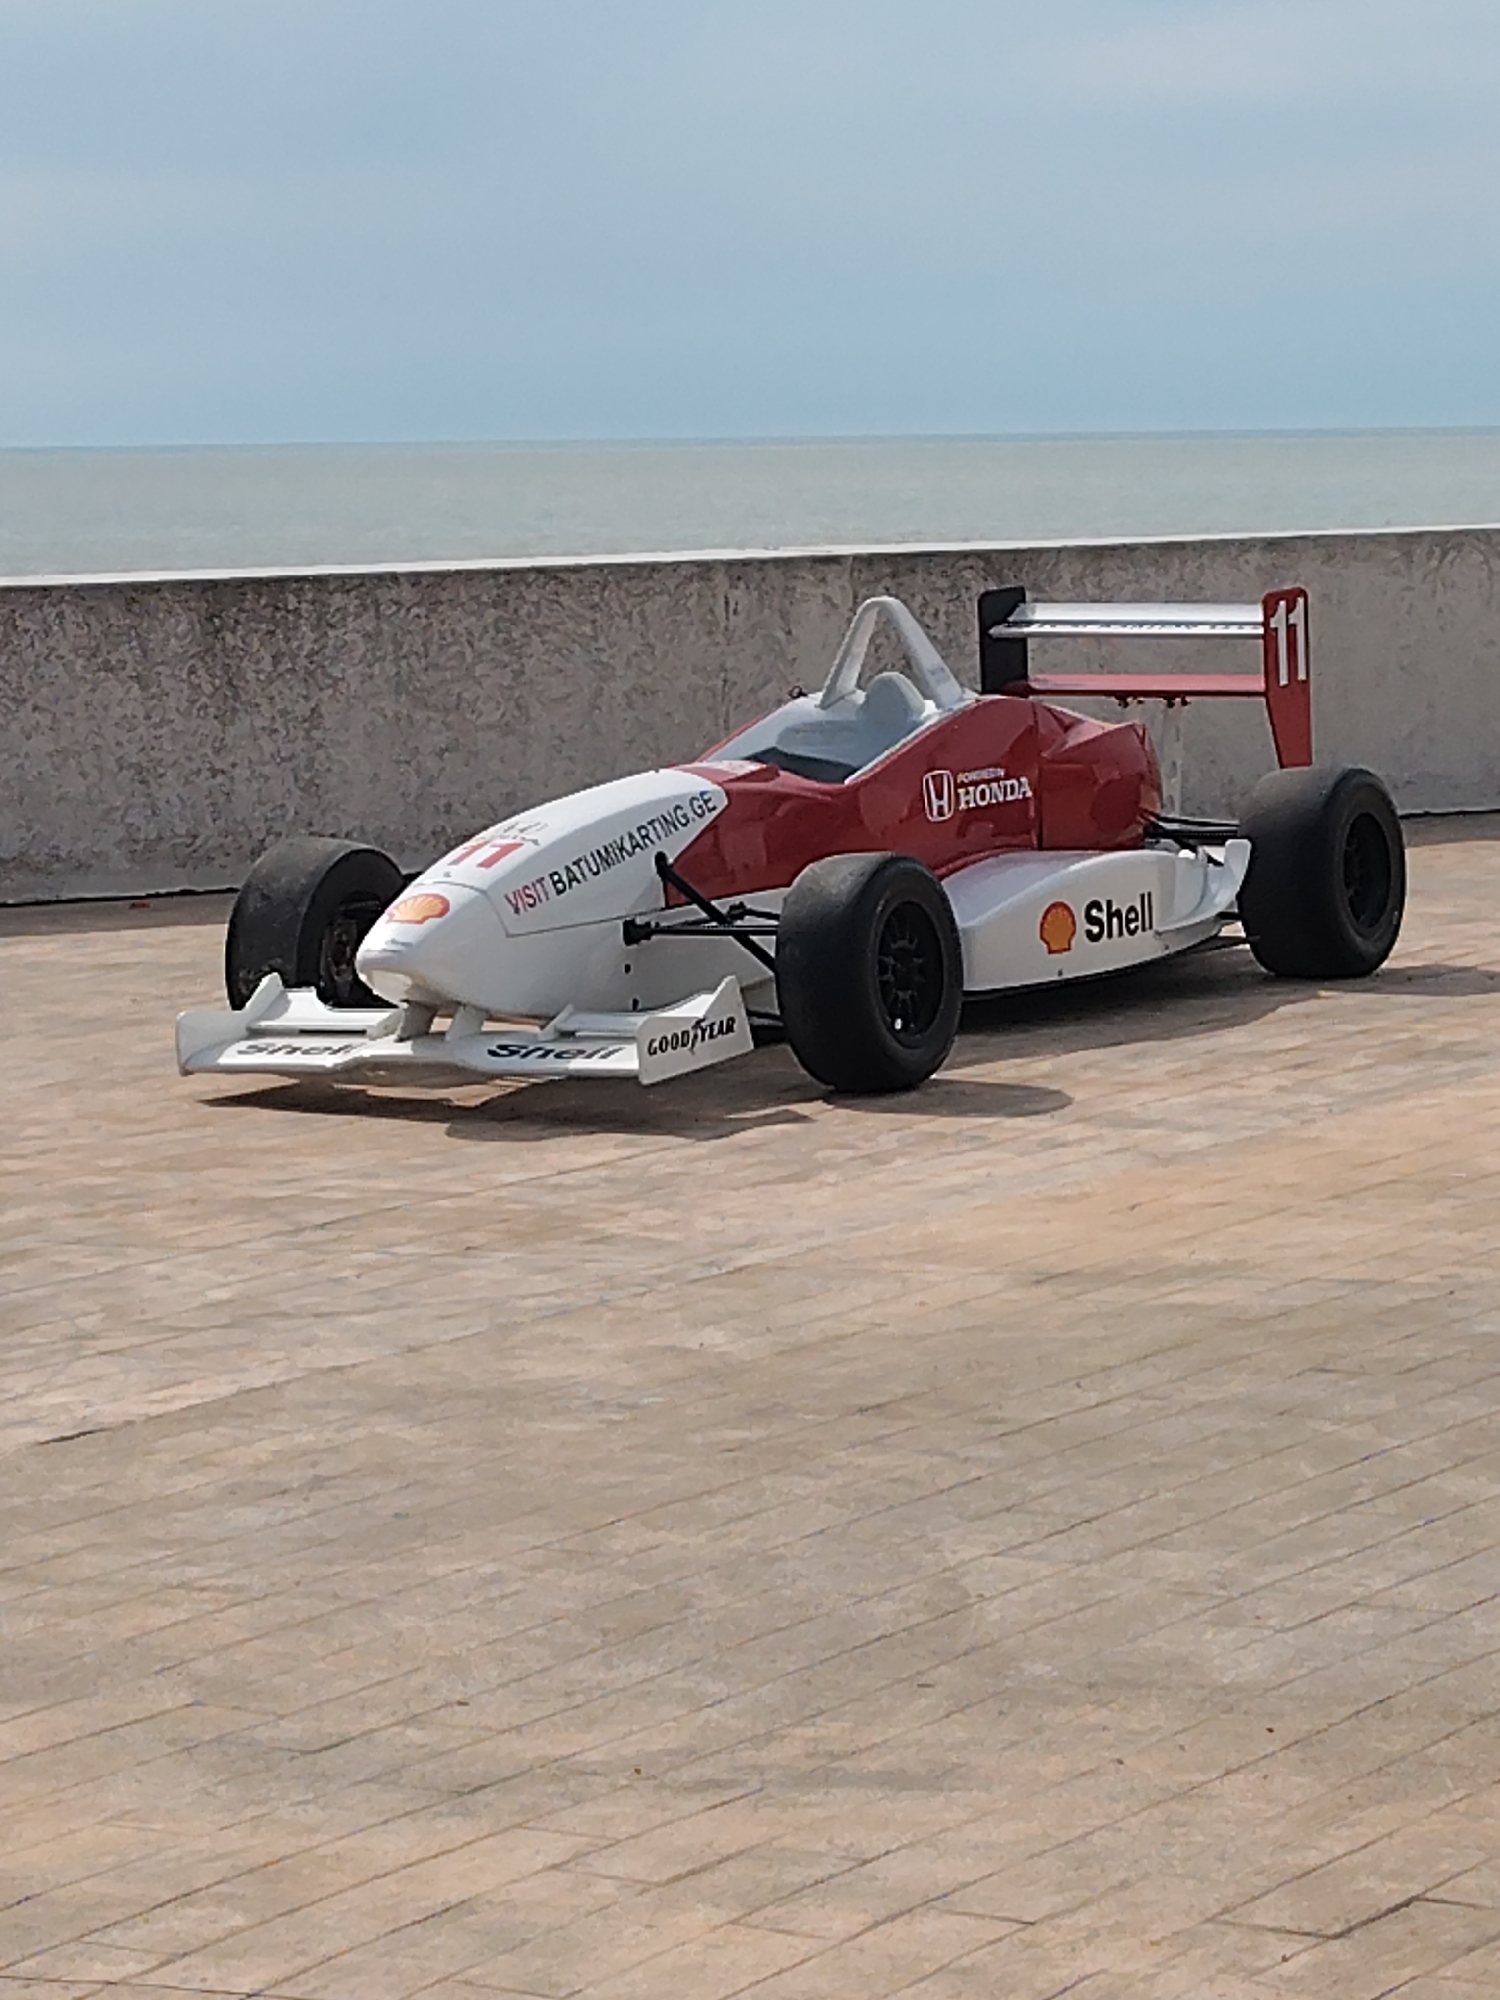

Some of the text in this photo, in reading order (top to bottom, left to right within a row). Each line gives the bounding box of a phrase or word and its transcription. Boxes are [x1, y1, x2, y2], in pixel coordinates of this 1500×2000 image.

[1269, 597, 1307, 687] 11
[957, 776, 1033, 811] HONDA
[447, 840, 524, 870] 11
[504, 790, 718, 915] VISIT BATUMIKARTING.GE
[1084, 890, 1153, 943] Shell
[487, 1044, 625, 1060] Shell
[647, 1016, 736, 1057] GOODYEAR
